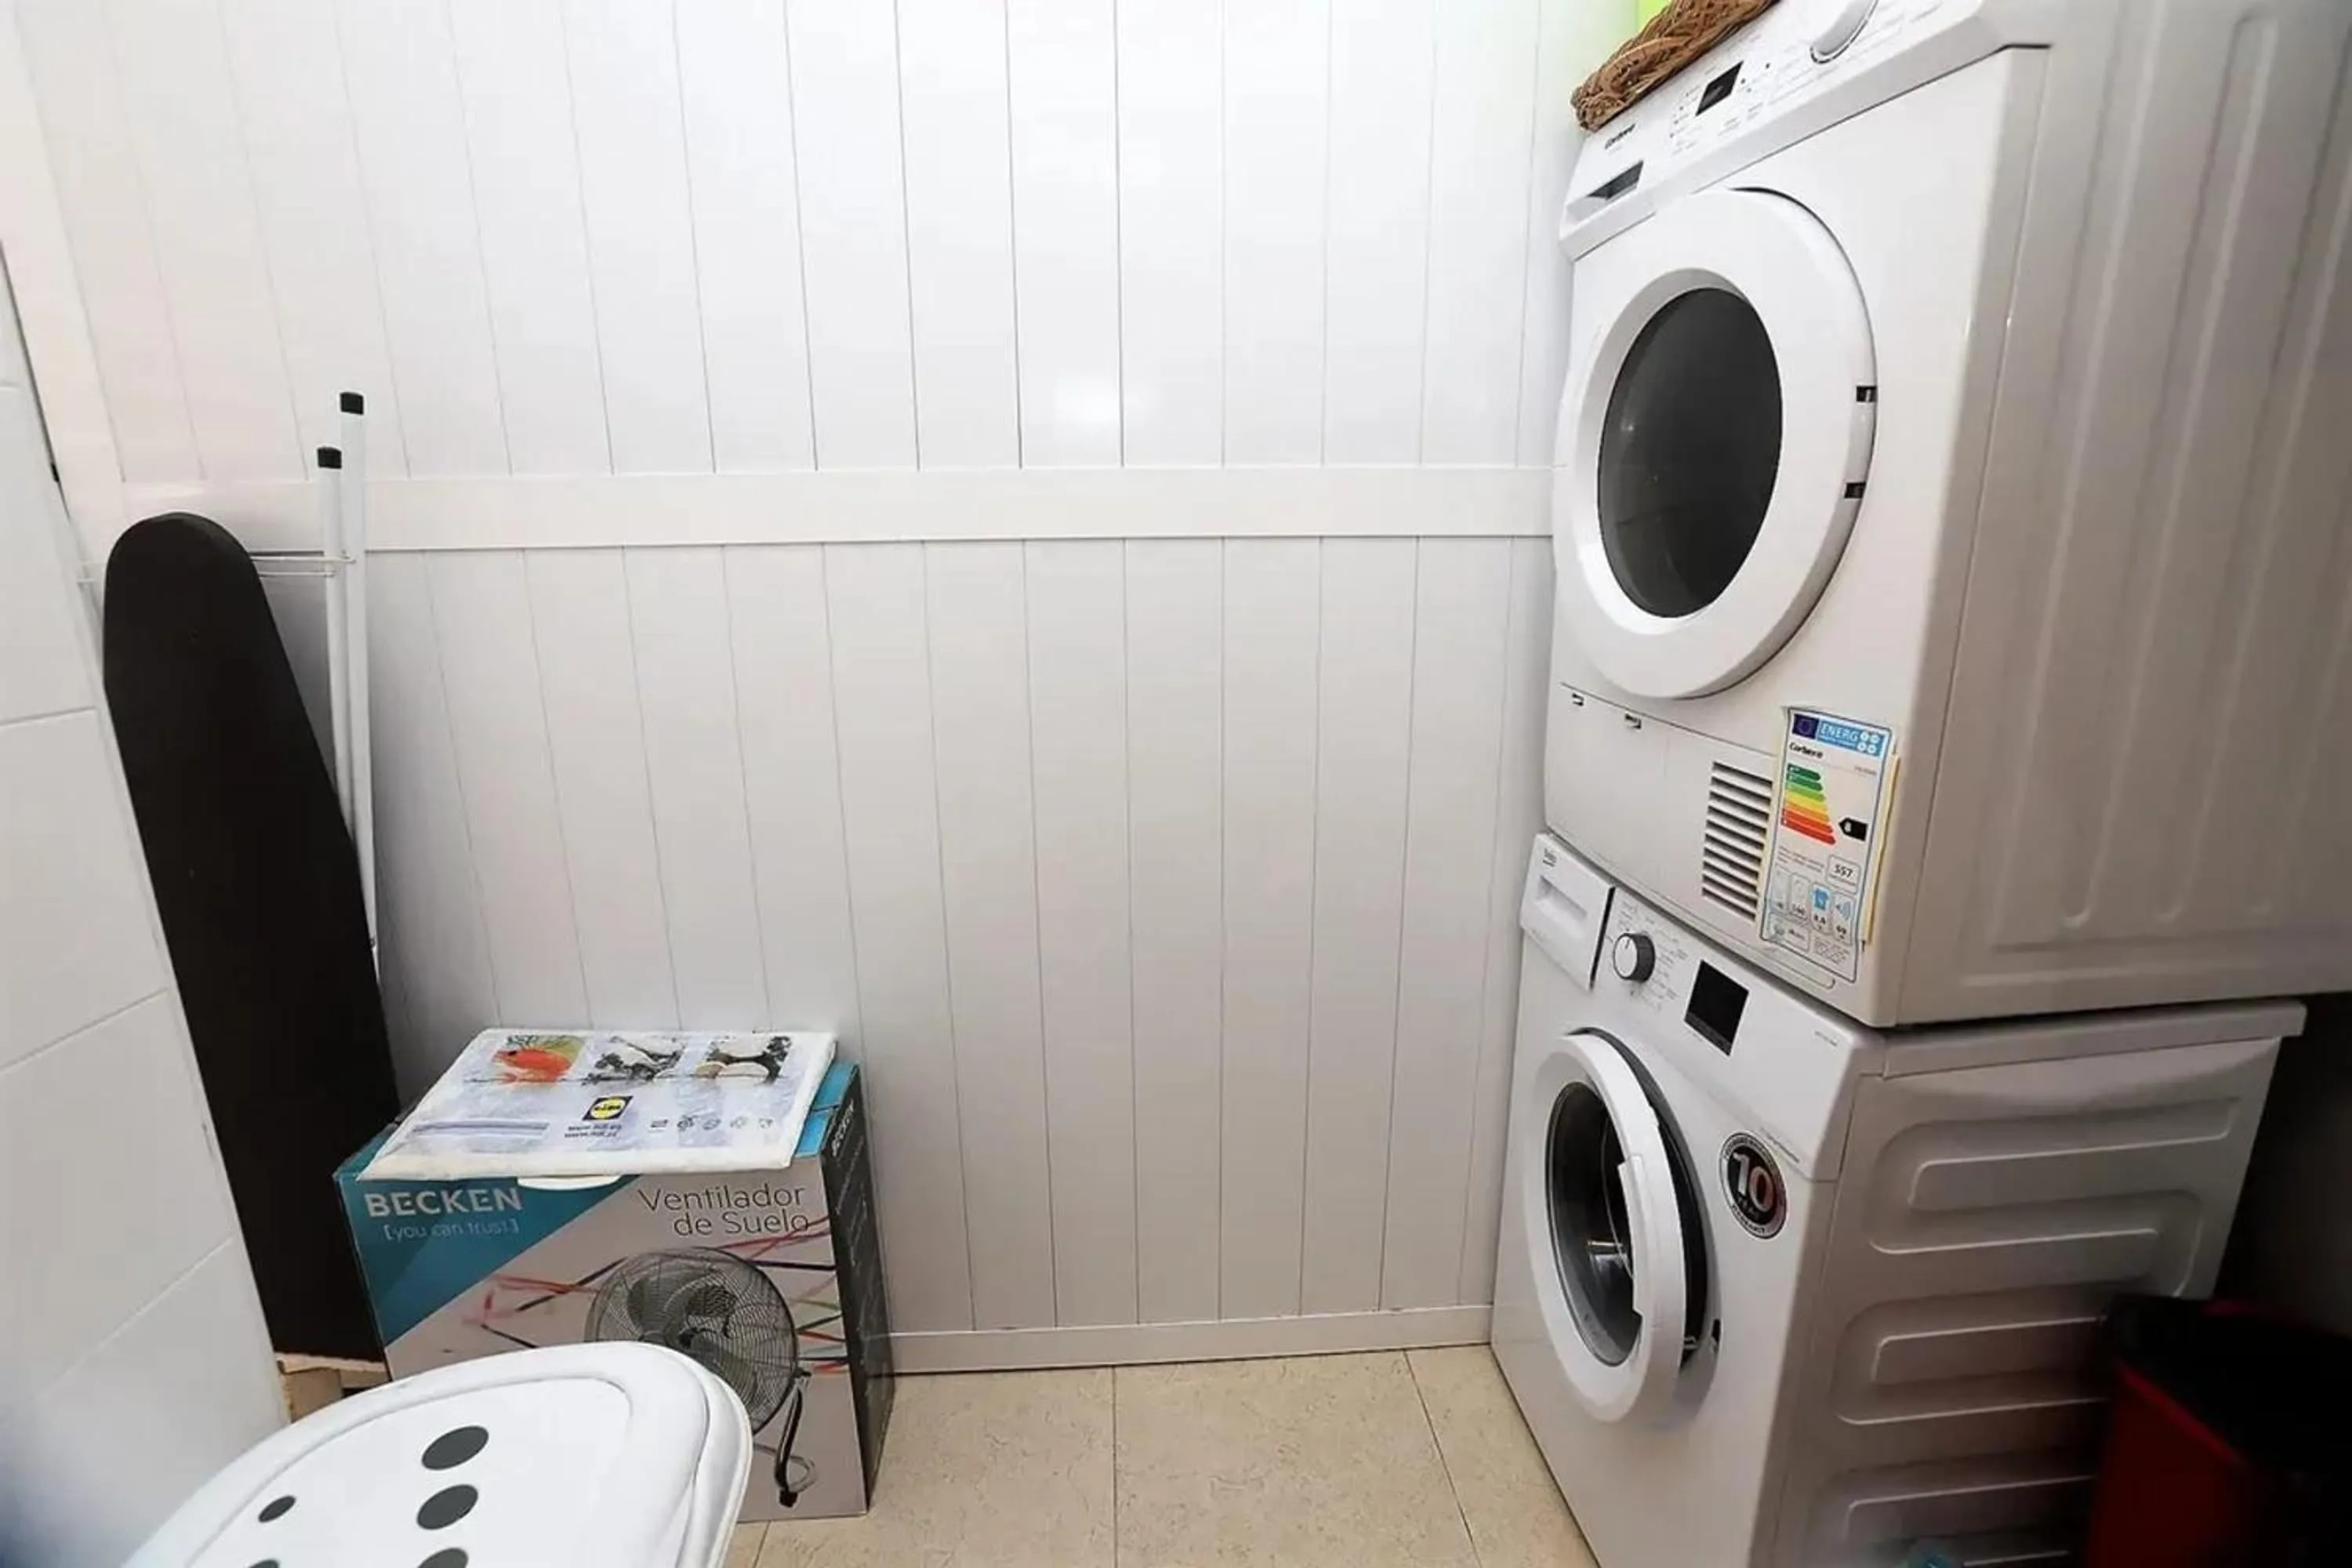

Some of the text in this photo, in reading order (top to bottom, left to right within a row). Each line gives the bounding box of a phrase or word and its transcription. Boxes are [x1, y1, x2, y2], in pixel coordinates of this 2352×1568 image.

[364, 1187, 524, 1217] BECKEN
[637, 1183, 806, 1211] Ventilador
[383, 1218, 520, 1242] [you can trust]
[673, 1209, 809, 1236] de Suelo
